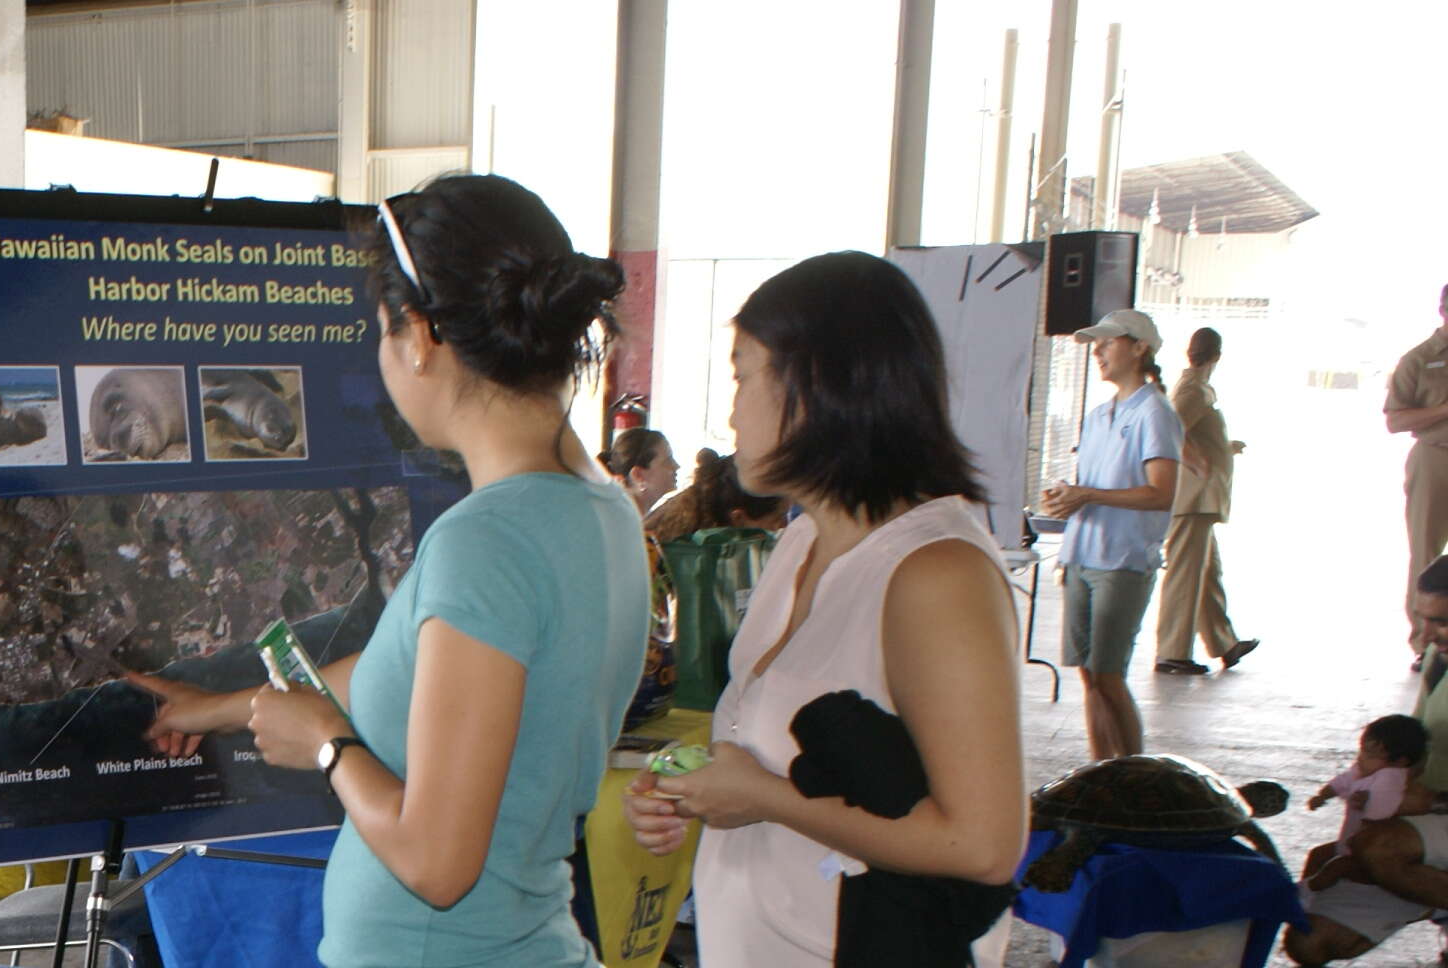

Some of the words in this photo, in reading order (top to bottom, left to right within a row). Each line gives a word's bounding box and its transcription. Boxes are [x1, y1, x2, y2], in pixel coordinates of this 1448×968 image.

[102, 236, 171, 262] Monk
[175, 238, 234, 264] Seals
[239, 245, 268, 265] on
[273, 241, 326, 266] Joint
[88, 275, 171, 301] Harbor
[176, 277, 260, 303] Hickam
[265, 280, 354, 305] Beaches
[82, 315, 157, 341] Where
[163, 316, 216, 341] have
[222, 323, 261, 347] you
[268, 323, 316, 342] seen
[322, 319, 367, 343] me?
[35, 765, 71, 781] Beach
[96, 759, 131, 775] White
[133, 757, 167, 771] Plains
